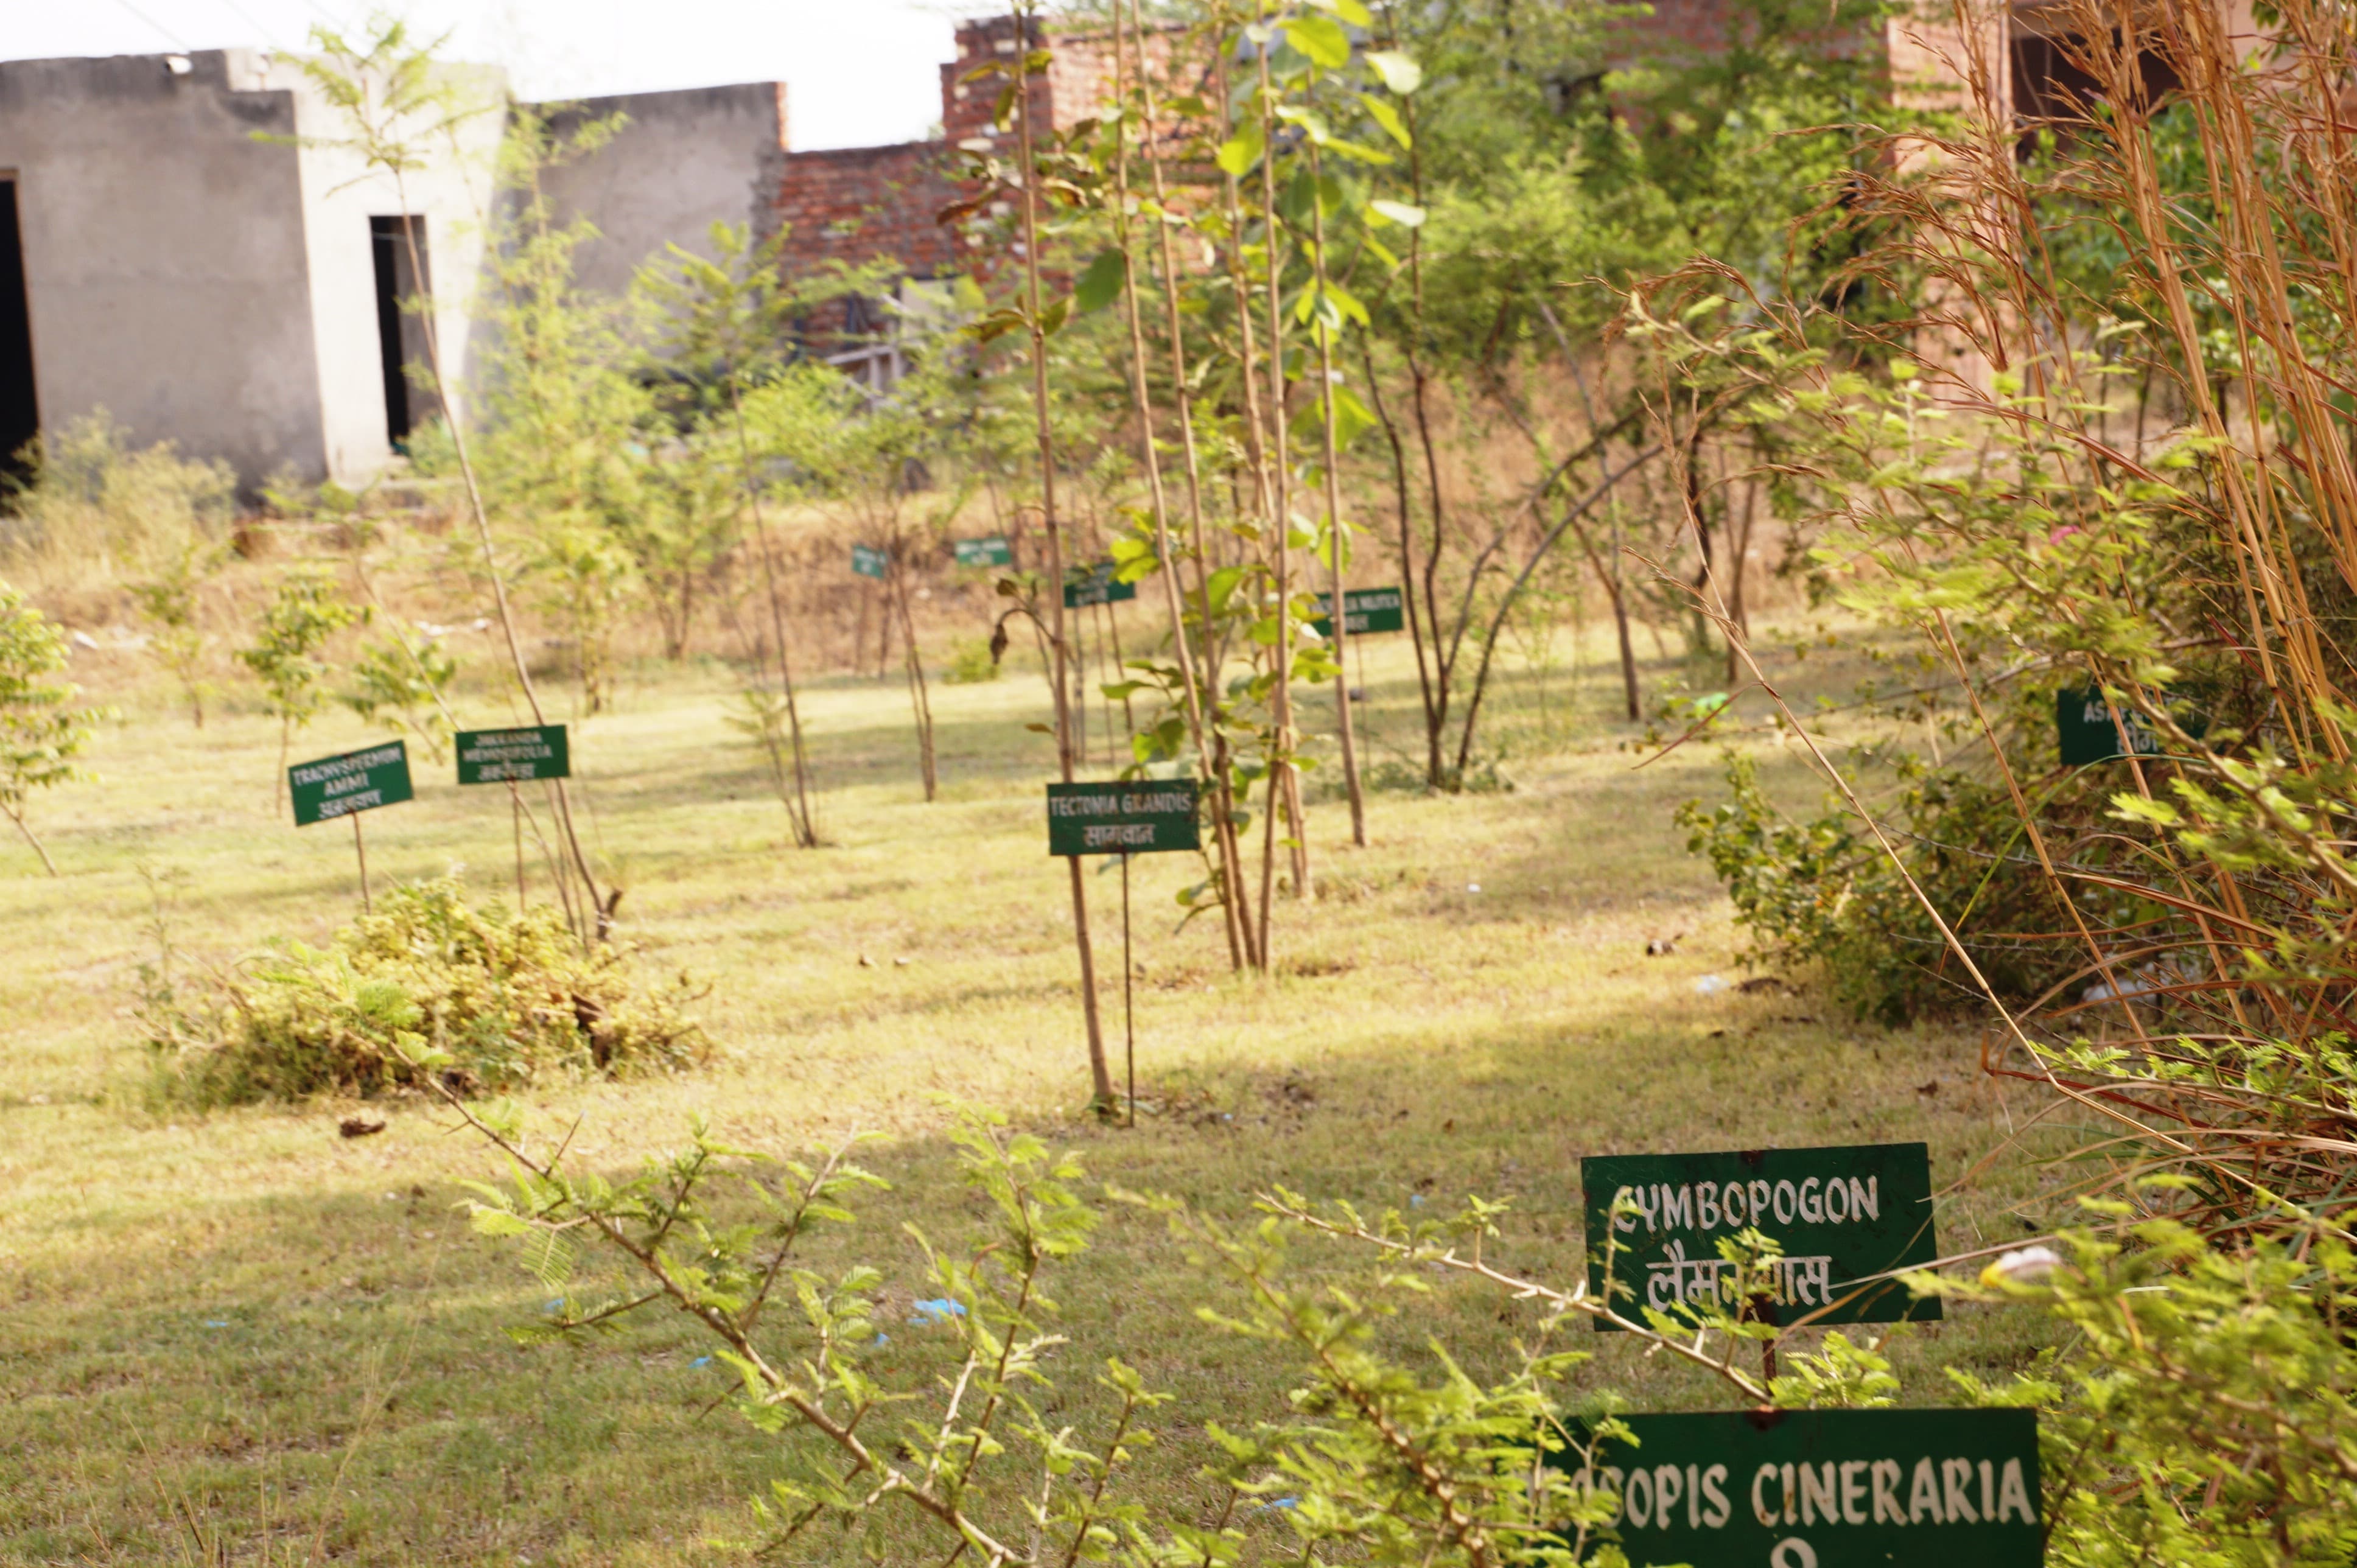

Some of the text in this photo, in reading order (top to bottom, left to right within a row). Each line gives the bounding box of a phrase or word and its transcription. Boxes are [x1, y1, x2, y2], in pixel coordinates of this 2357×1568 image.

[323, 773, 369, 797] AMMI
[1612, 1175, 1880, 1234] CYMBOPOGON
[1751, 1457, 2037, 1528] CINERARIA
